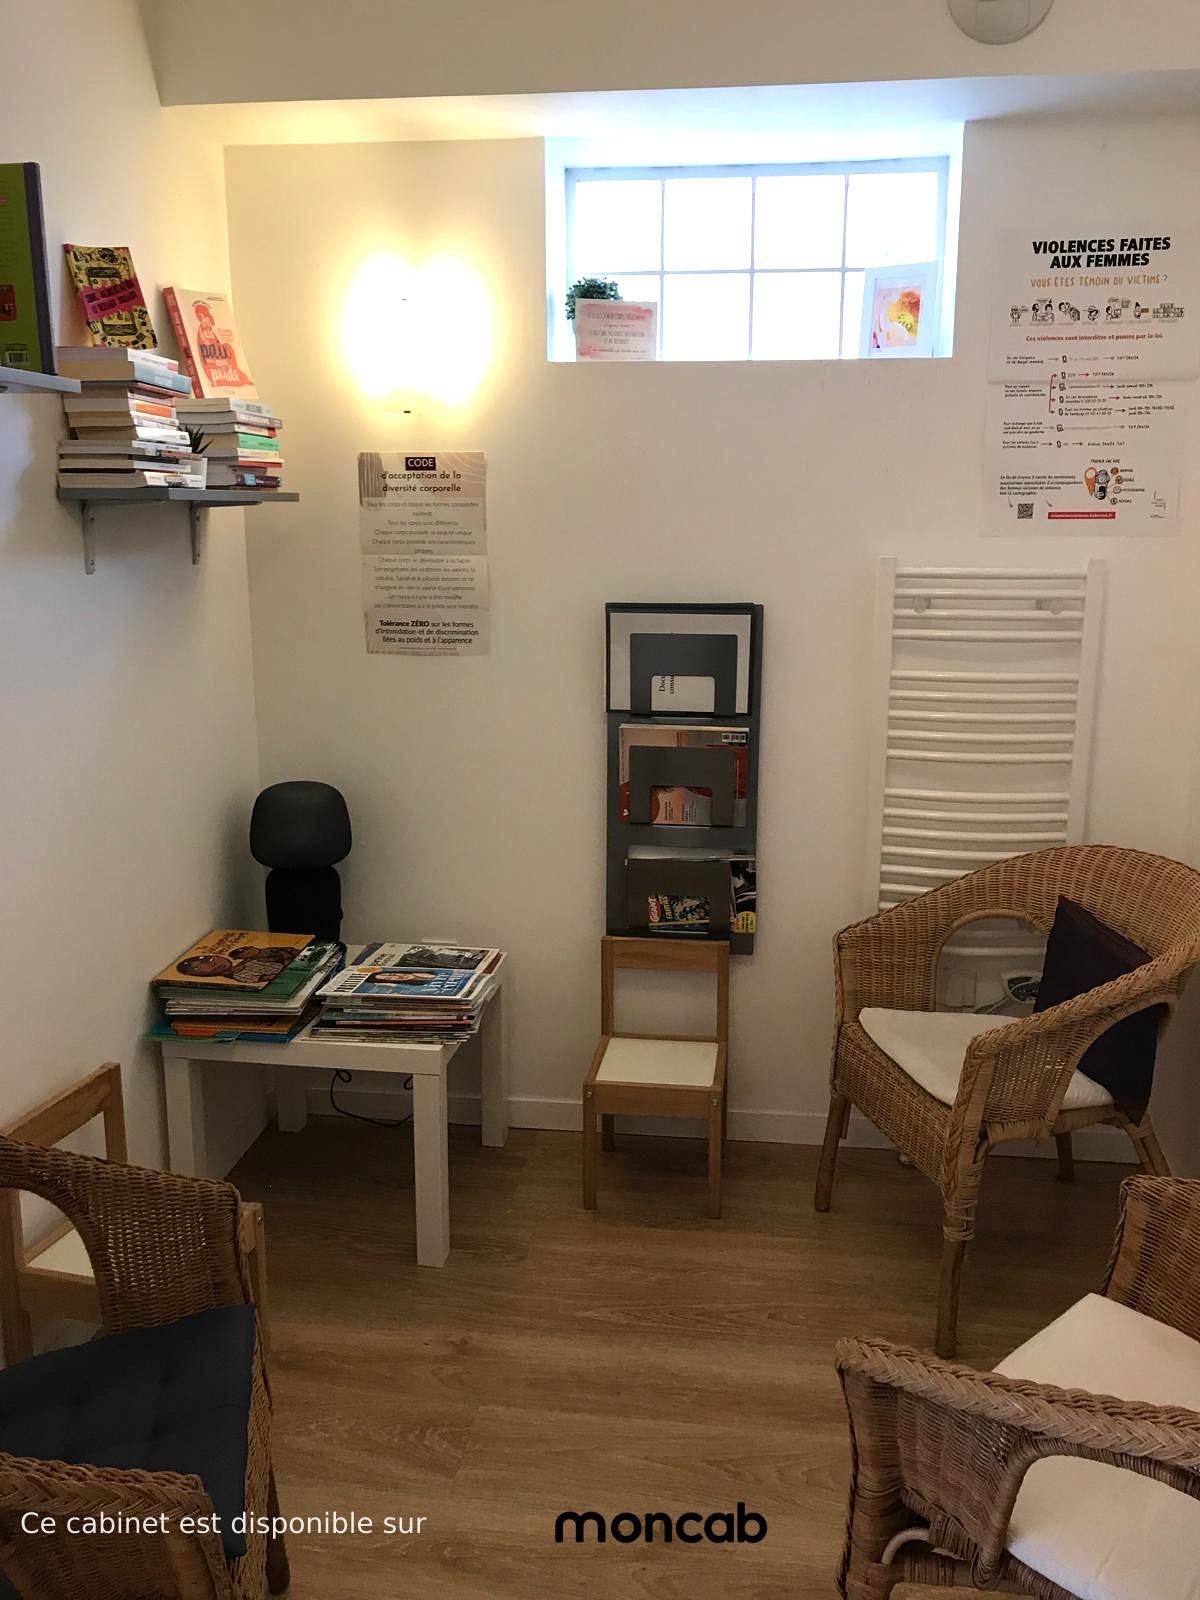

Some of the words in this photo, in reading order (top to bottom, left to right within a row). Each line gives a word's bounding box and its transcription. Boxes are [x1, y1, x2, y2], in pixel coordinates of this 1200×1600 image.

[1032, 239, 1115, 254] VIOLENCES
[1119, 237, 1171, 252] FAITES
[1050, 255, 1082, 268] AUX
[1086, 253, 1150, 268] FEMMES
[1030, 277, 1052, 288] VOUS
[1113, 276, 1124, 285] OU
[1135, 333, 1146, 341] par
[407, 458, 435, 467] CODE
[381, 470, 438, 481] d'acceptation
[440, 470, 450, 479] de
[453, 470, 462, 479] la
[382, 483, 417, 492] diversité
[420, 483, 462, 493] corporelle
[452, 620, 474, 628] formes
[435, 628, 479, 636] discrimination
[406, 636, 423, 644] poids
